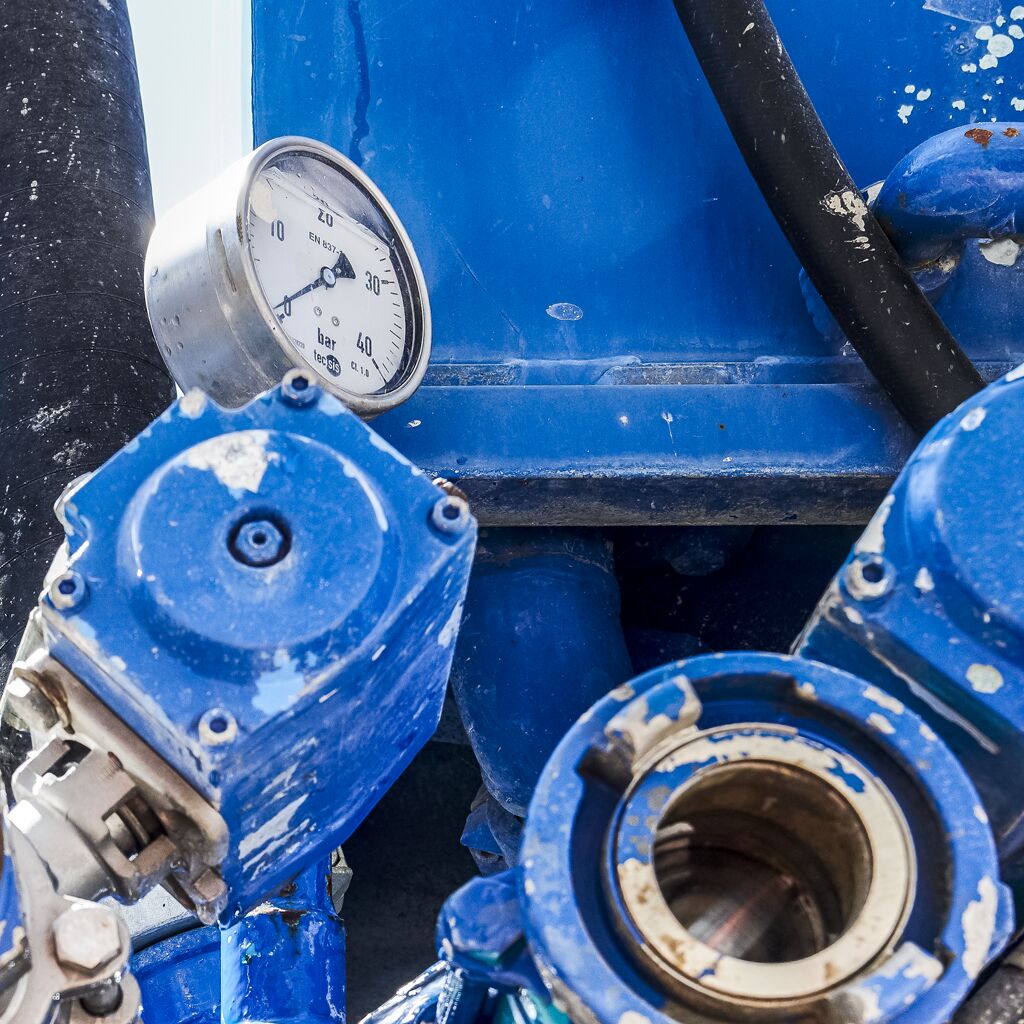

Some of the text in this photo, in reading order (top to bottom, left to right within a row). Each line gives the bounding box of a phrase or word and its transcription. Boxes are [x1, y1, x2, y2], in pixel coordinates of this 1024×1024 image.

[308, 231, 343, 256] EN 837-
[365, 270, 381, 297] 30
[317, 327, 336, 351] bar
[356, 331, 373, 358] 40
[313, 348, 342, 378] tecsis
